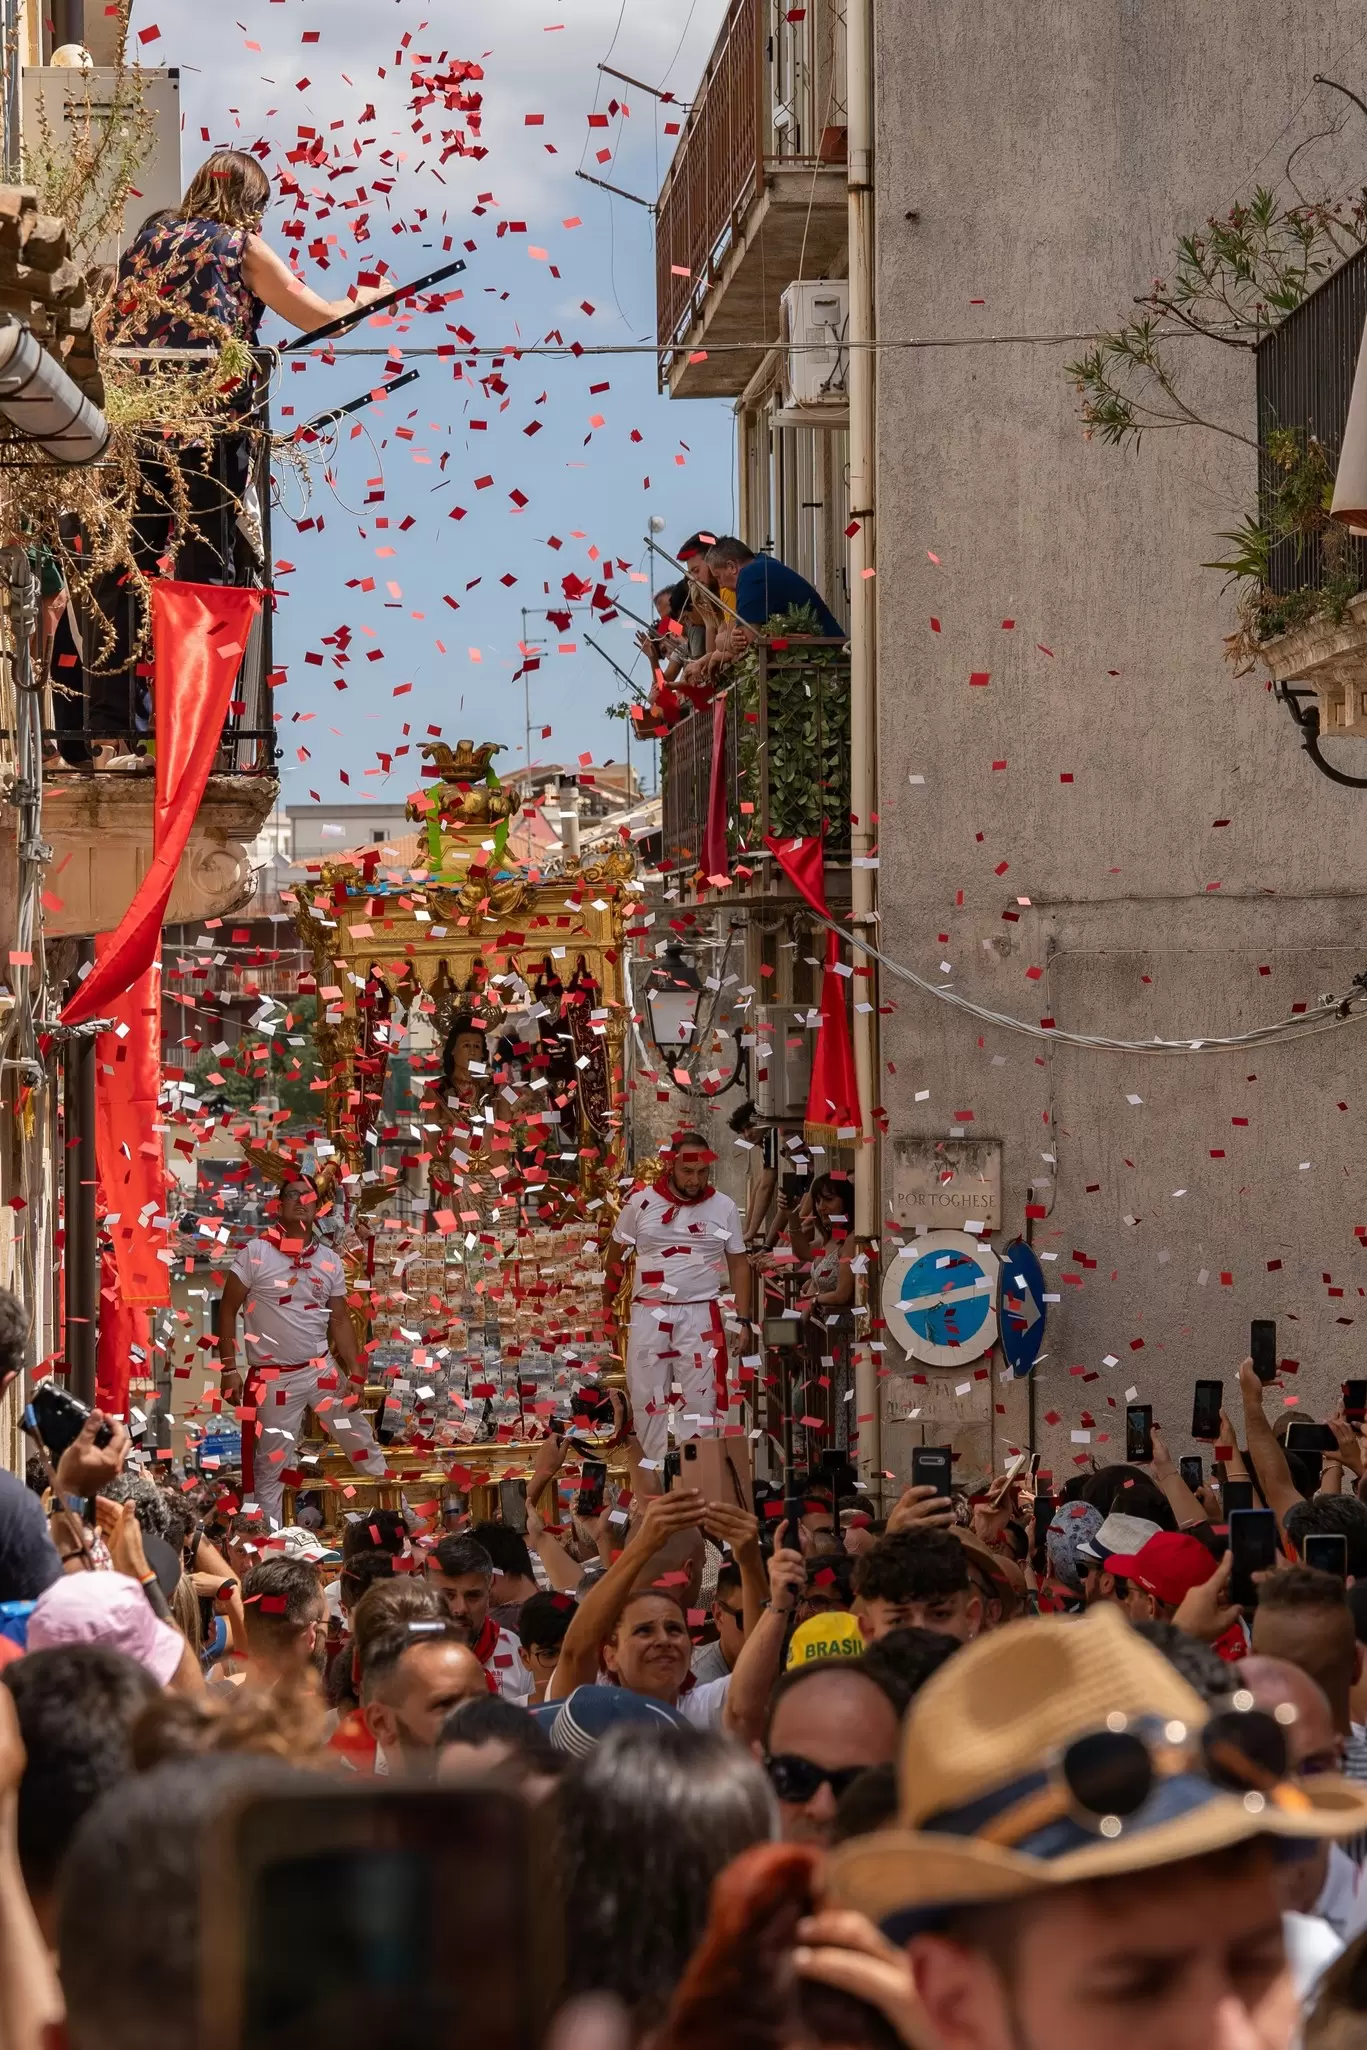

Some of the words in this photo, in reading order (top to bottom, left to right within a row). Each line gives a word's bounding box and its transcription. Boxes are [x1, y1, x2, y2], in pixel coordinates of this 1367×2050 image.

[934, 1162, 960, 1175] VIA
[897, 1193, 997, 1208] PORTOGHESE
[805, 1638, 864, 1659] BRASIL
